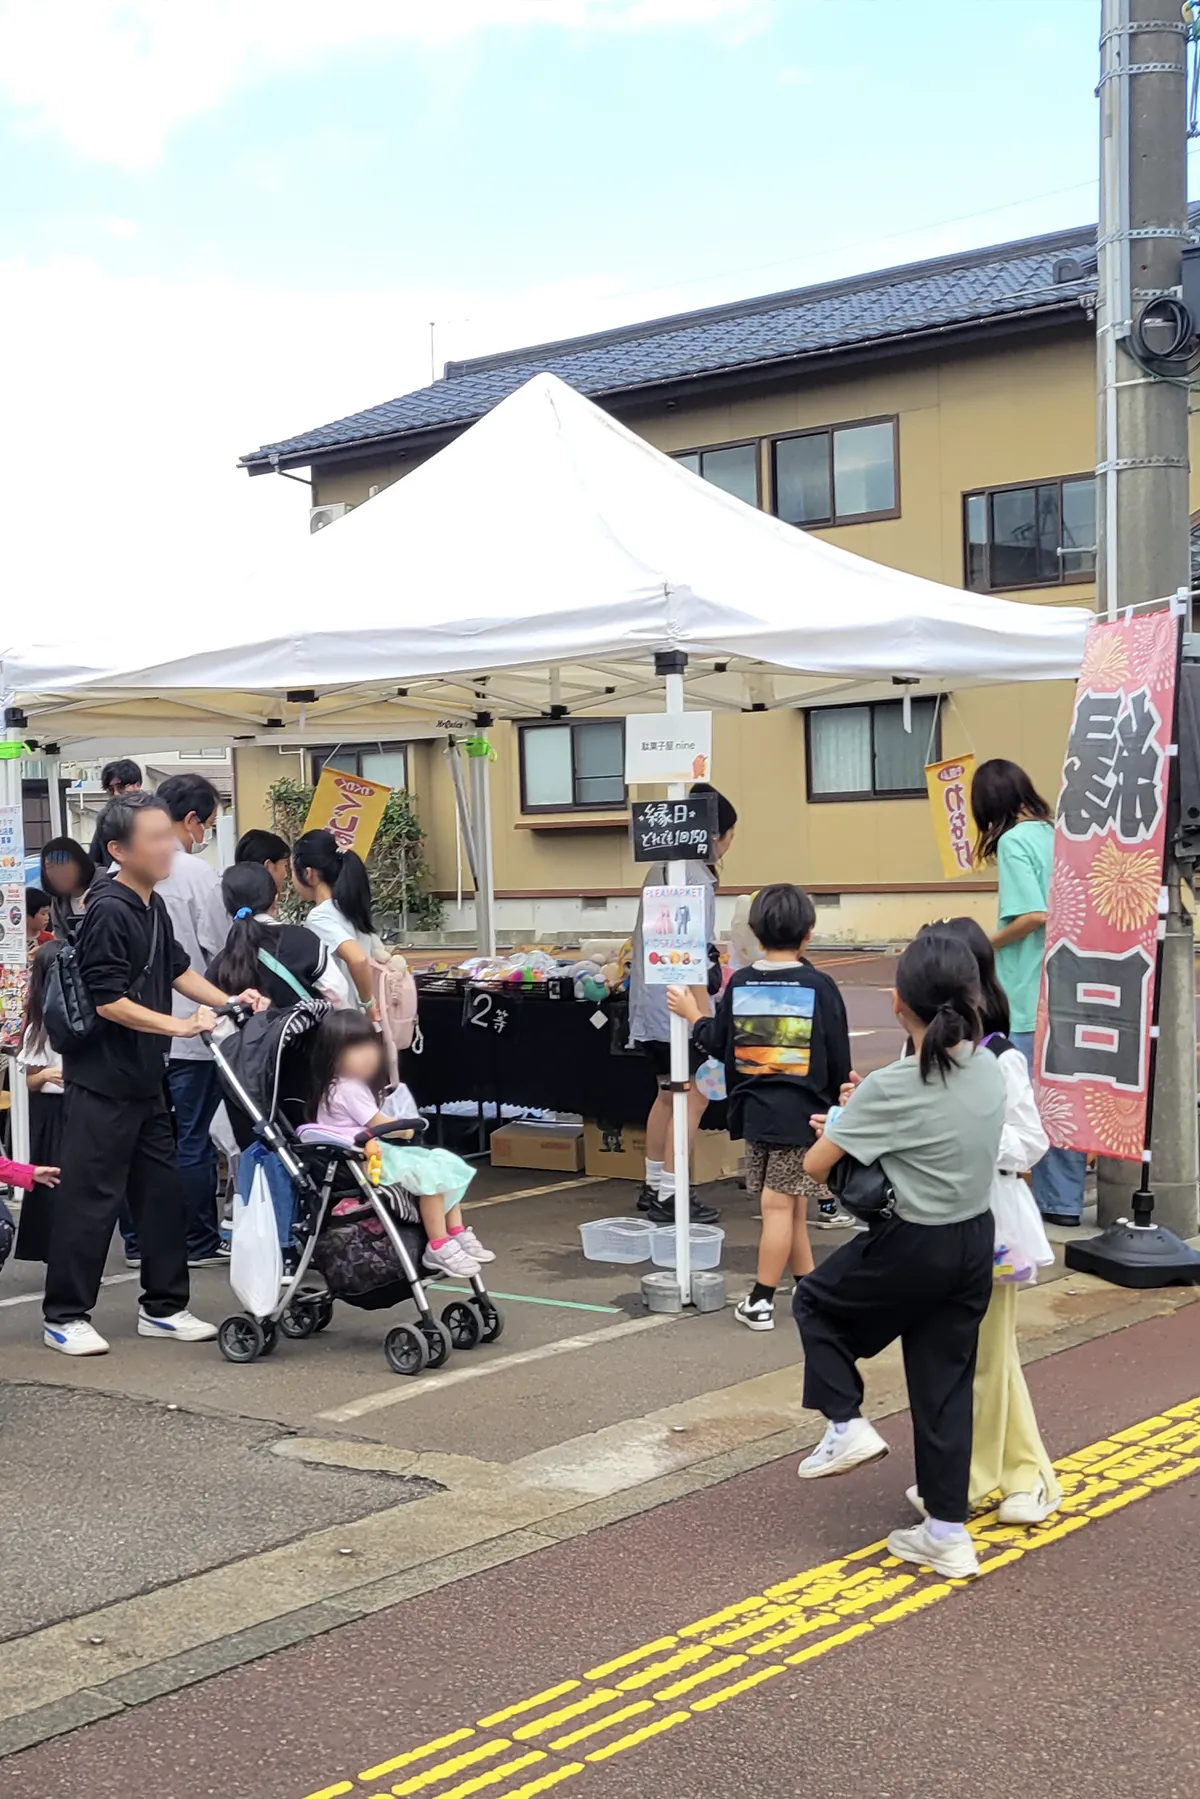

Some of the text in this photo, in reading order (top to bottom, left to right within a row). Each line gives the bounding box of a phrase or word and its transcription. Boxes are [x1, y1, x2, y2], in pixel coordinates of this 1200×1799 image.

[641, 740, 696, 752] 駄菓子屋 nine
[644, 804, 688, 827] 縁日
[696, 843, 709, 855] 円
